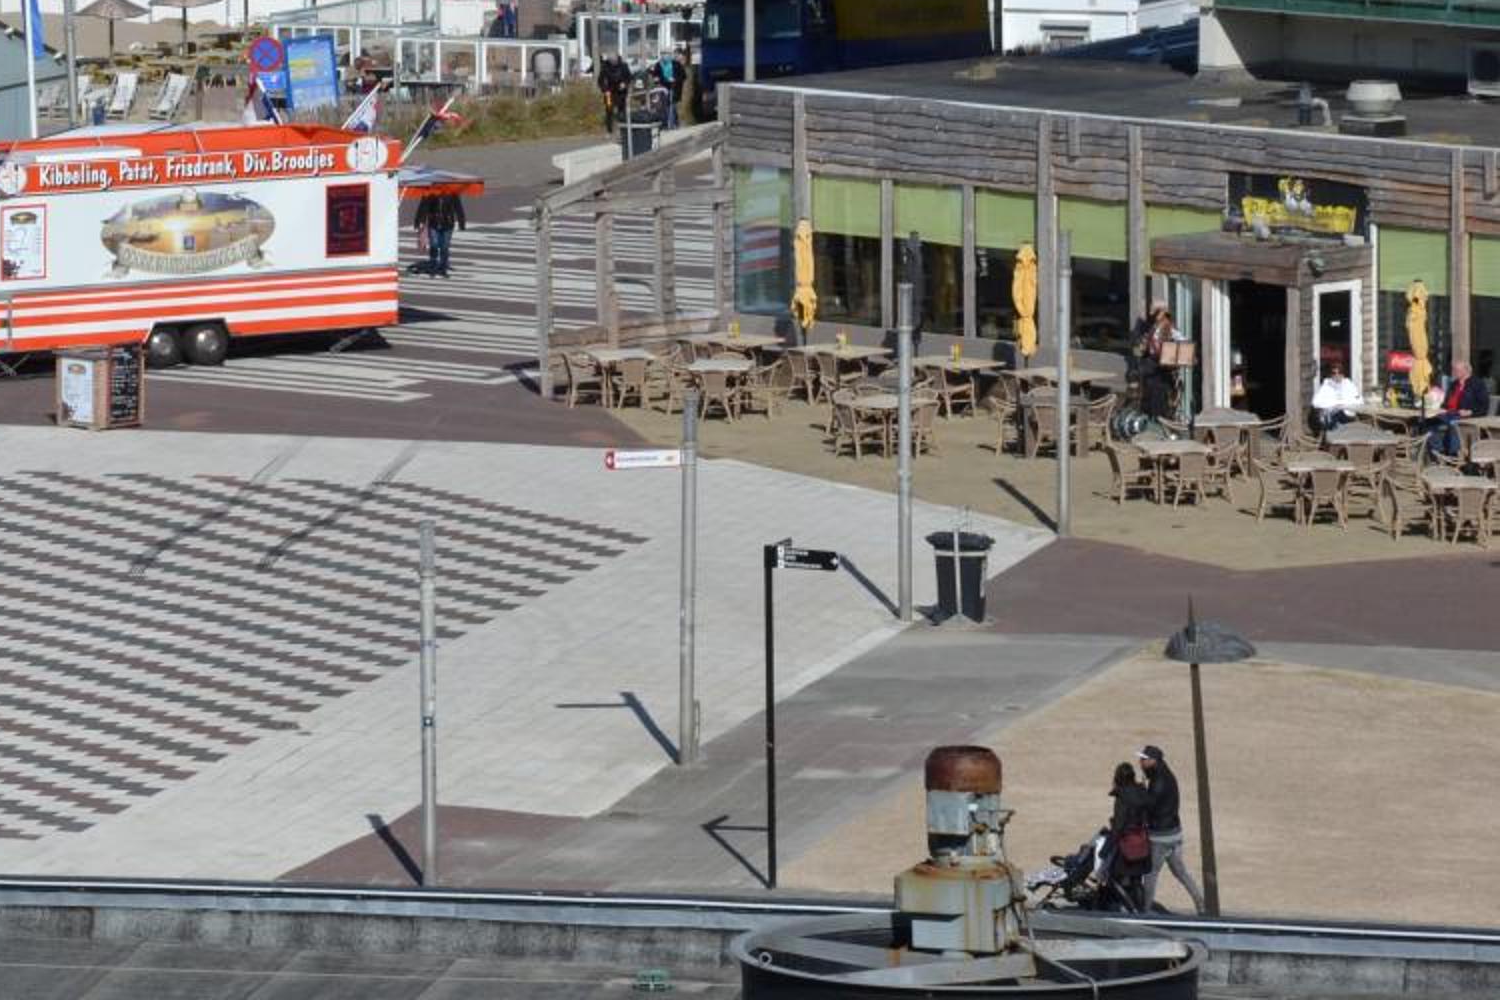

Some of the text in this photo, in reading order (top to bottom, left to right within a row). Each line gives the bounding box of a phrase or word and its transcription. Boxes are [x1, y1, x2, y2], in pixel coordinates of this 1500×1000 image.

[39, 148, 335, 188] Kibbeling, Patat, Frisdrank, Div.Broodjes
